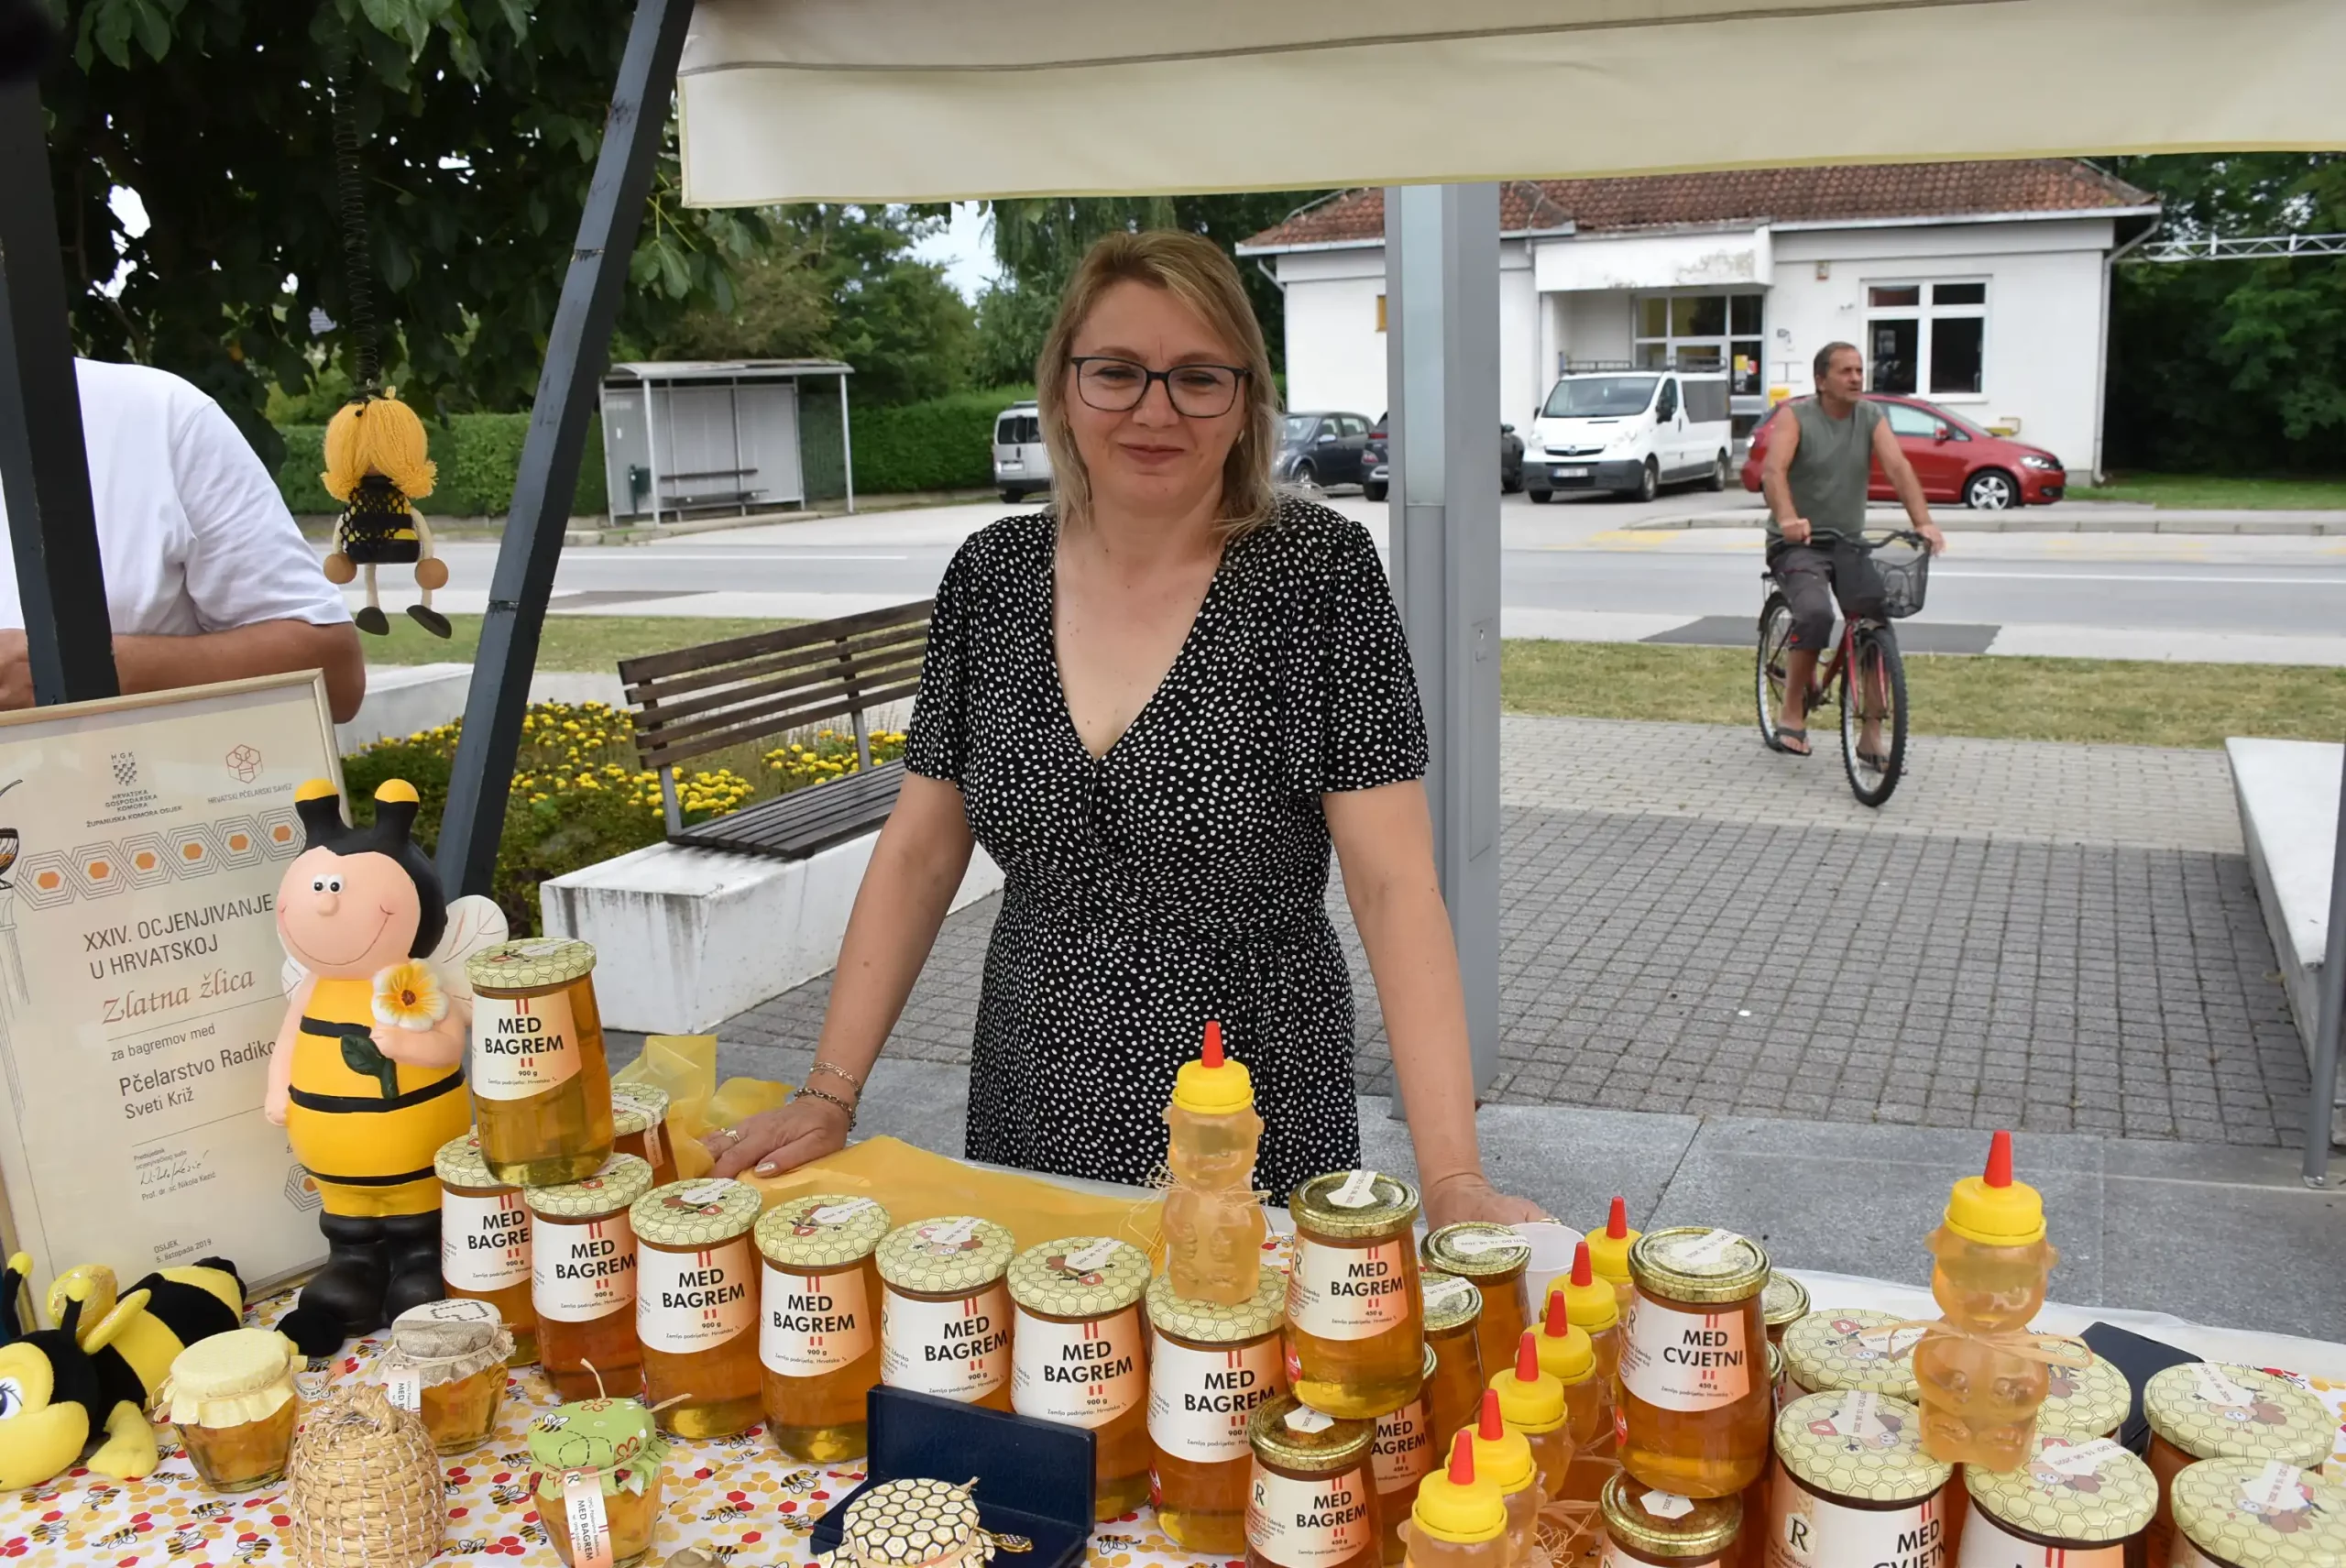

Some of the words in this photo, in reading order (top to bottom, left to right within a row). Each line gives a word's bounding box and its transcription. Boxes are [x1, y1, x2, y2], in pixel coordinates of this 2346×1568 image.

[105, 795, 158, 807] GOSPODARSKA
[112, 790, 148, 799] HRVATSKA
[208, 794, 238, 803] HRVATSKI
[117, 803, 148, 812] KOMORA
[128, 810, 158, 820] KOMORA
[159, 806, 182, 814] OSIJEK
[83, 925, 132, 952] XXIV.
[137, 894, 274, 940] OCJENJIVANJE
[90, 960, 104, 980] U
[110, 934, 219, 976] HRVATSKOJ
[102, 982, 191, 1025] Zlatna
[200, 968, 256, 999] žlica
[499, 1017, 542, 1034] MED
[111, 1048, 125, 1061] za
[128, 1033, 187, 1058] bagremov
[191, 1024, 215, 1040] med
[485, 1035, 564, 1055] BAGREM
[119, 1056, 215, 1096] Pčelarstvo
[125, 1098, 163, 1120] Sveti
[167, 1086, 194, 1106] Križ
[483, 1211, 525, 1230] MED
[468, 1228, 530, 1249] BAGRE
[572, 1240, 615, 1258] MED
[164, 1245, 193, 1260] listopada
[555, 1253, 637, 1278] BAGREM
[1294, 1253, 1301, 1275] R
[1348, 1261, 1388, 1277] MED
[679, 1268, 724, 1288] MED
[1331, 1277, 1403, 1297] BAGREM
[663, 1283, 745, 1308] BAGREM
[788, 1294, 832, 1311] MED
[773, 1311, 855, 1332] BAGREM
[882, 1310, 888, 1335] R
[944, 1316, 990, 1339] MED
[1628, 1310, 1636, 1334] R
[925, 1329, 1007, 1361] BAGREM
[1683, 1330, 1727, 1347] MED
[1063, 1341, 1112, 1361] MED
[1663, 1347, 1743, 1367] CVJETNI
[1044, 1355, 1133, 1383] BAGREM
[1204, 1370, 1255, 1389] MED
[1184, 1386, 1275, 1412] BAGREM
[1377, 1420, 1412, 1438] MED
[1371, 1432, 1425, 1455] AGREM
[567, 1474, 579, 1484] R
[1255, 1483, 1265, 1506] R
[1313, 1491, 1352, 1509] MED
[577, 1500, 586, 1520] MED
[1296, 1502, 1365, 1528] BAGREM
[581, 1523, 593, 1562] BAGREM
[1789, 1517, 1808, 1552] R
[1897, 1519, 1939, 1553] MED
